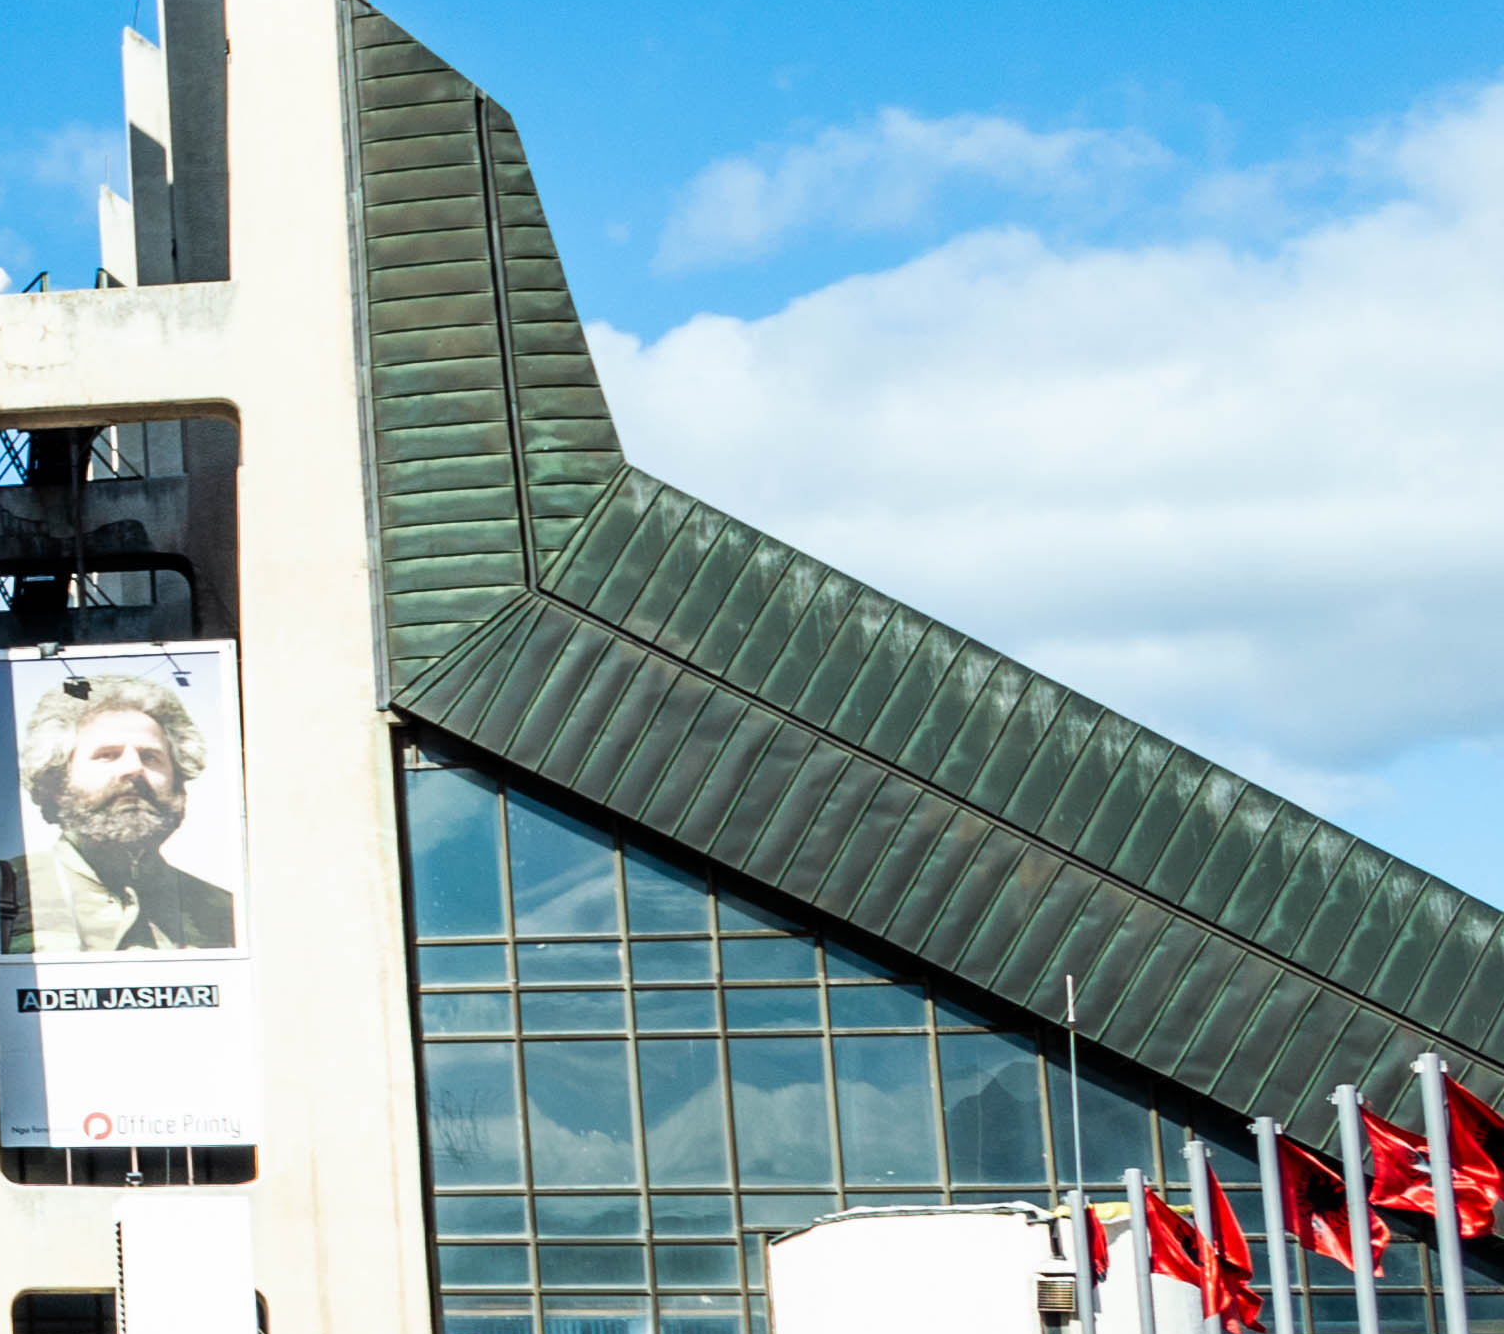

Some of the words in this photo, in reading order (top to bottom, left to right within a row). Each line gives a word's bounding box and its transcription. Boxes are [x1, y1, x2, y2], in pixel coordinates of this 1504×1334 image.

[23, 988, 98, 1010] ADEM
[102, 985, 219, 1008] JASHARI
[117, 1115, 177, 1135] Office
